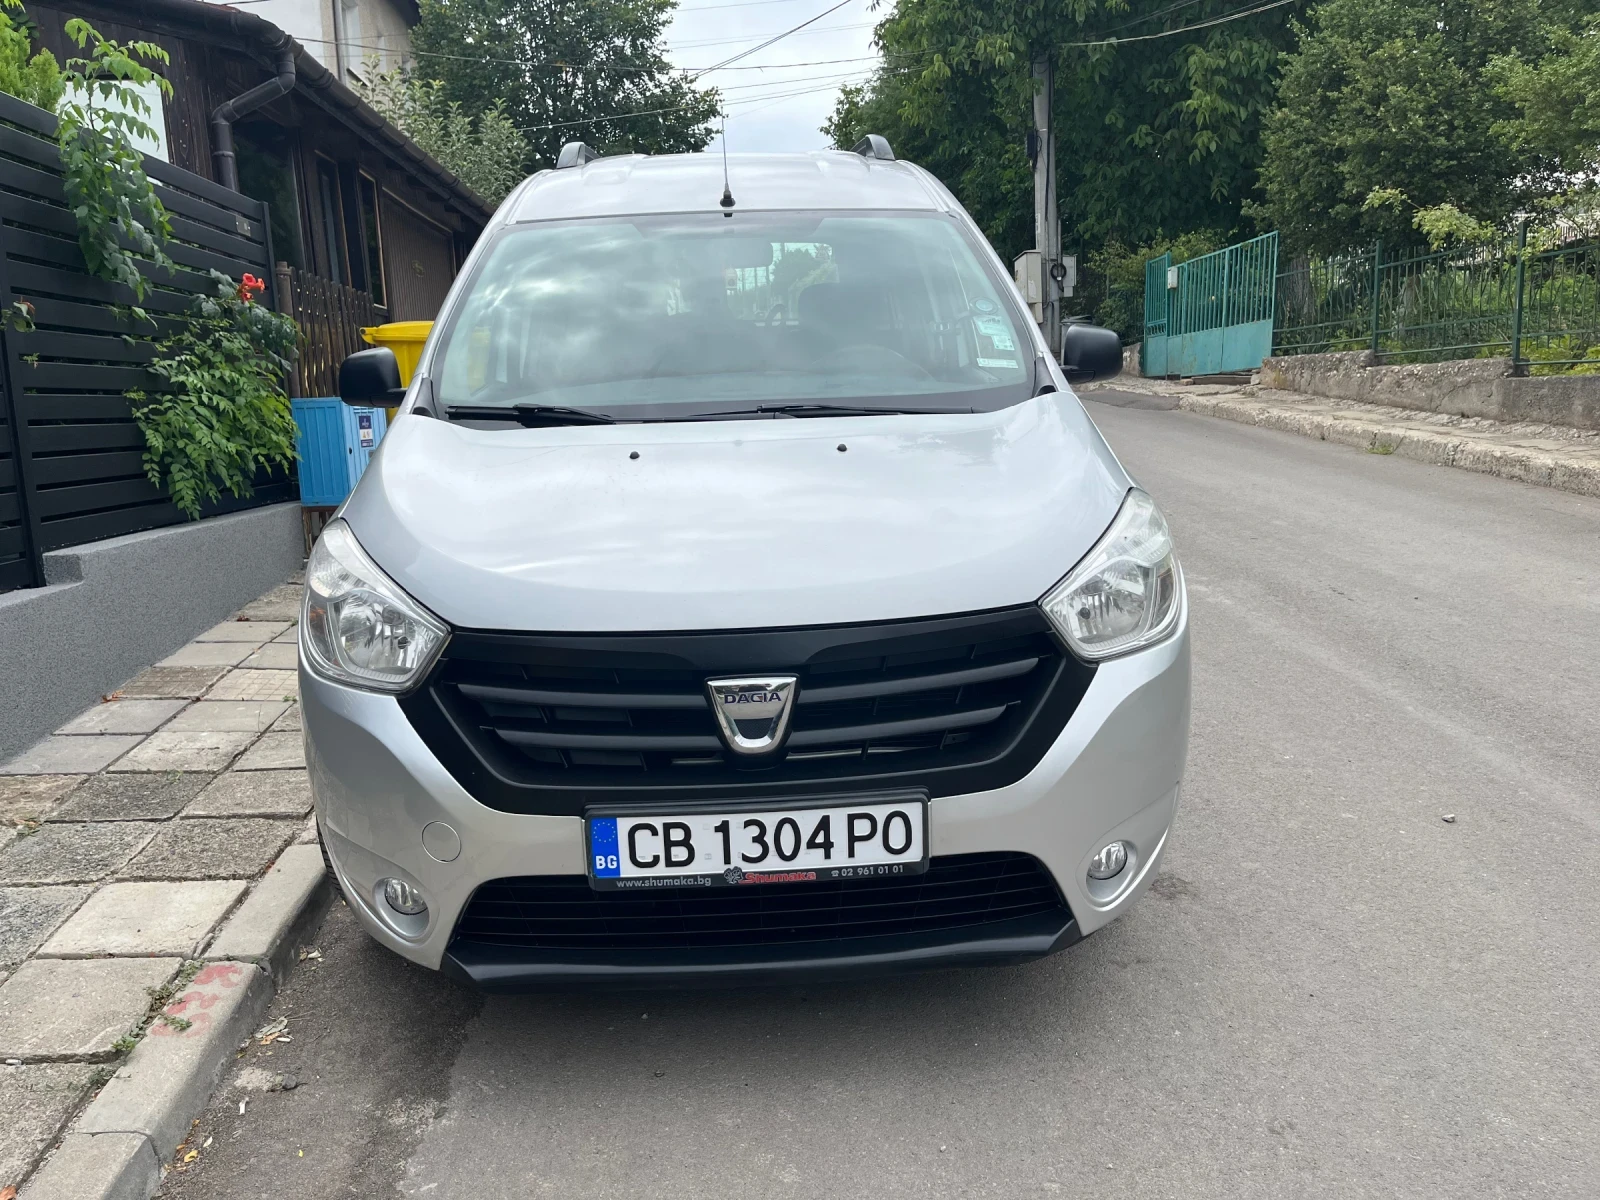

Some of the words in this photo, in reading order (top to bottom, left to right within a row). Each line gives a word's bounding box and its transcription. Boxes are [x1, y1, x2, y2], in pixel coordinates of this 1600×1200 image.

[724, 692, 782, 703] DACIA
[628, 822, 695, 868] CB
[714, 815, 834, 865] 1304
[846, 810, 912, 858] PO
[595, 855, 618, 870] BG
[742, 871, 816, 883] Shumaka
[841, 868, 853, 877] 02
[857, 867, 875, 876] 961
[877, 866, 889, 875] 01
[892, 865, 904, 874] 01
[616, 876, 712, 888] www.shumaka.bg
